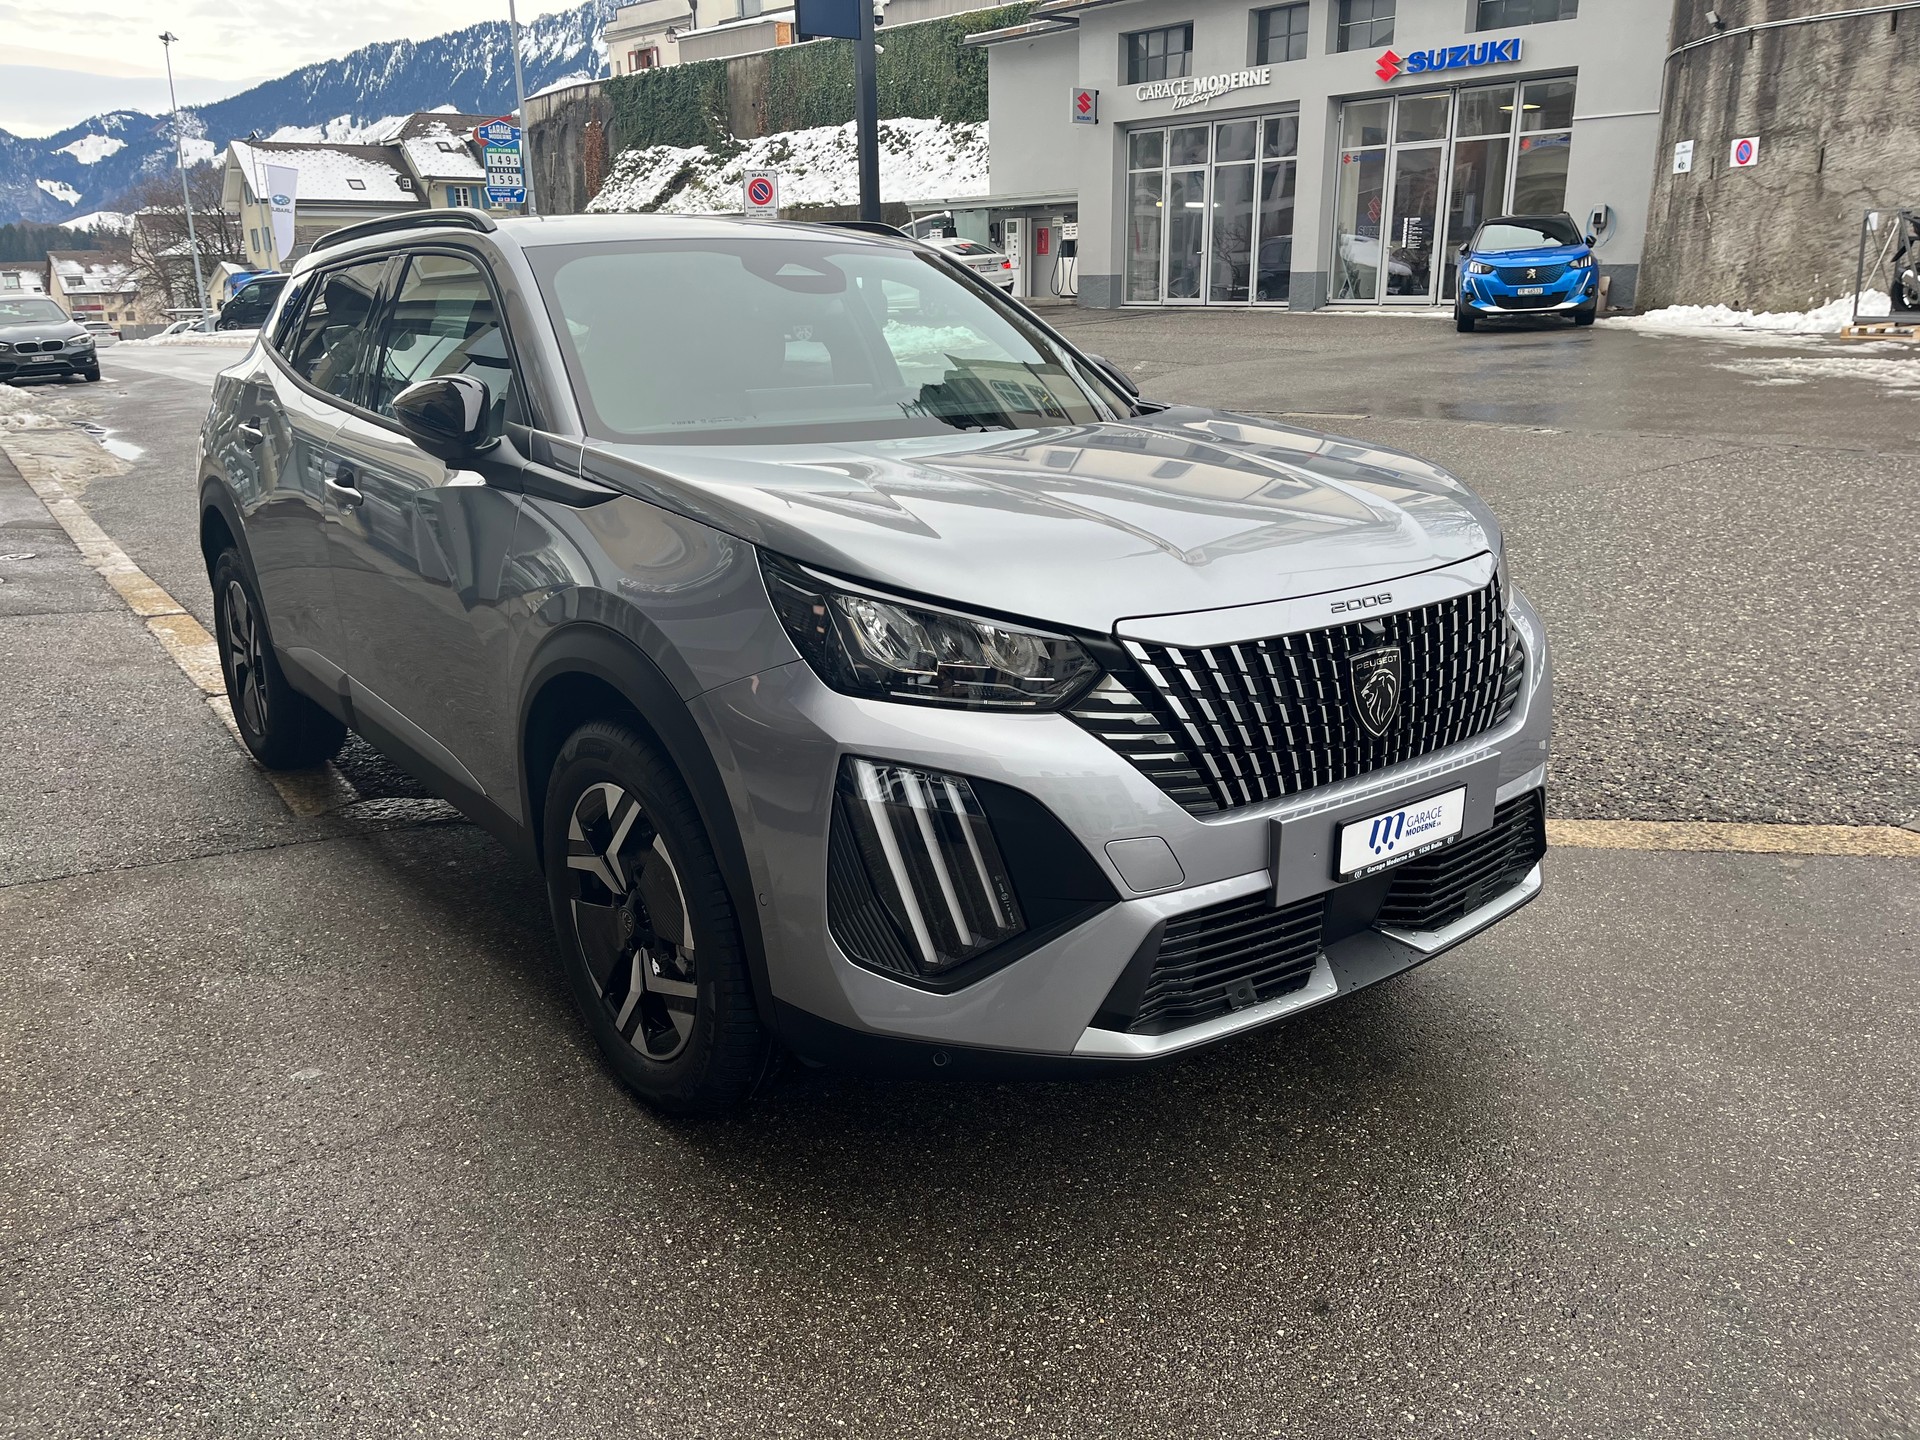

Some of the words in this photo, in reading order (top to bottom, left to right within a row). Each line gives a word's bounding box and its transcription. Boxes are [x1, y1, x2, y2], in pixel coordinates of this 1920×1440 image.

[1406, 38, 1521, 73] SUZUKI
[1136, 79, 1188, 101] GARAGE
[1193, 67, 1270, 93] MODERNE
[487, 124, 511, 134] GARAGE
[1331, 592, 1393, 613] 2008
[1356, 655, 1397, 671] PEUGEOT
[1406, 806, 1442, 827] GARAGE
[1406, 820, 1436, 837] MODERNE
[1367, 862, 1386, 873] Garage
[1386, 854, 1408, 866] Moderne
[1431, 841, 1442, 850] Bulle
